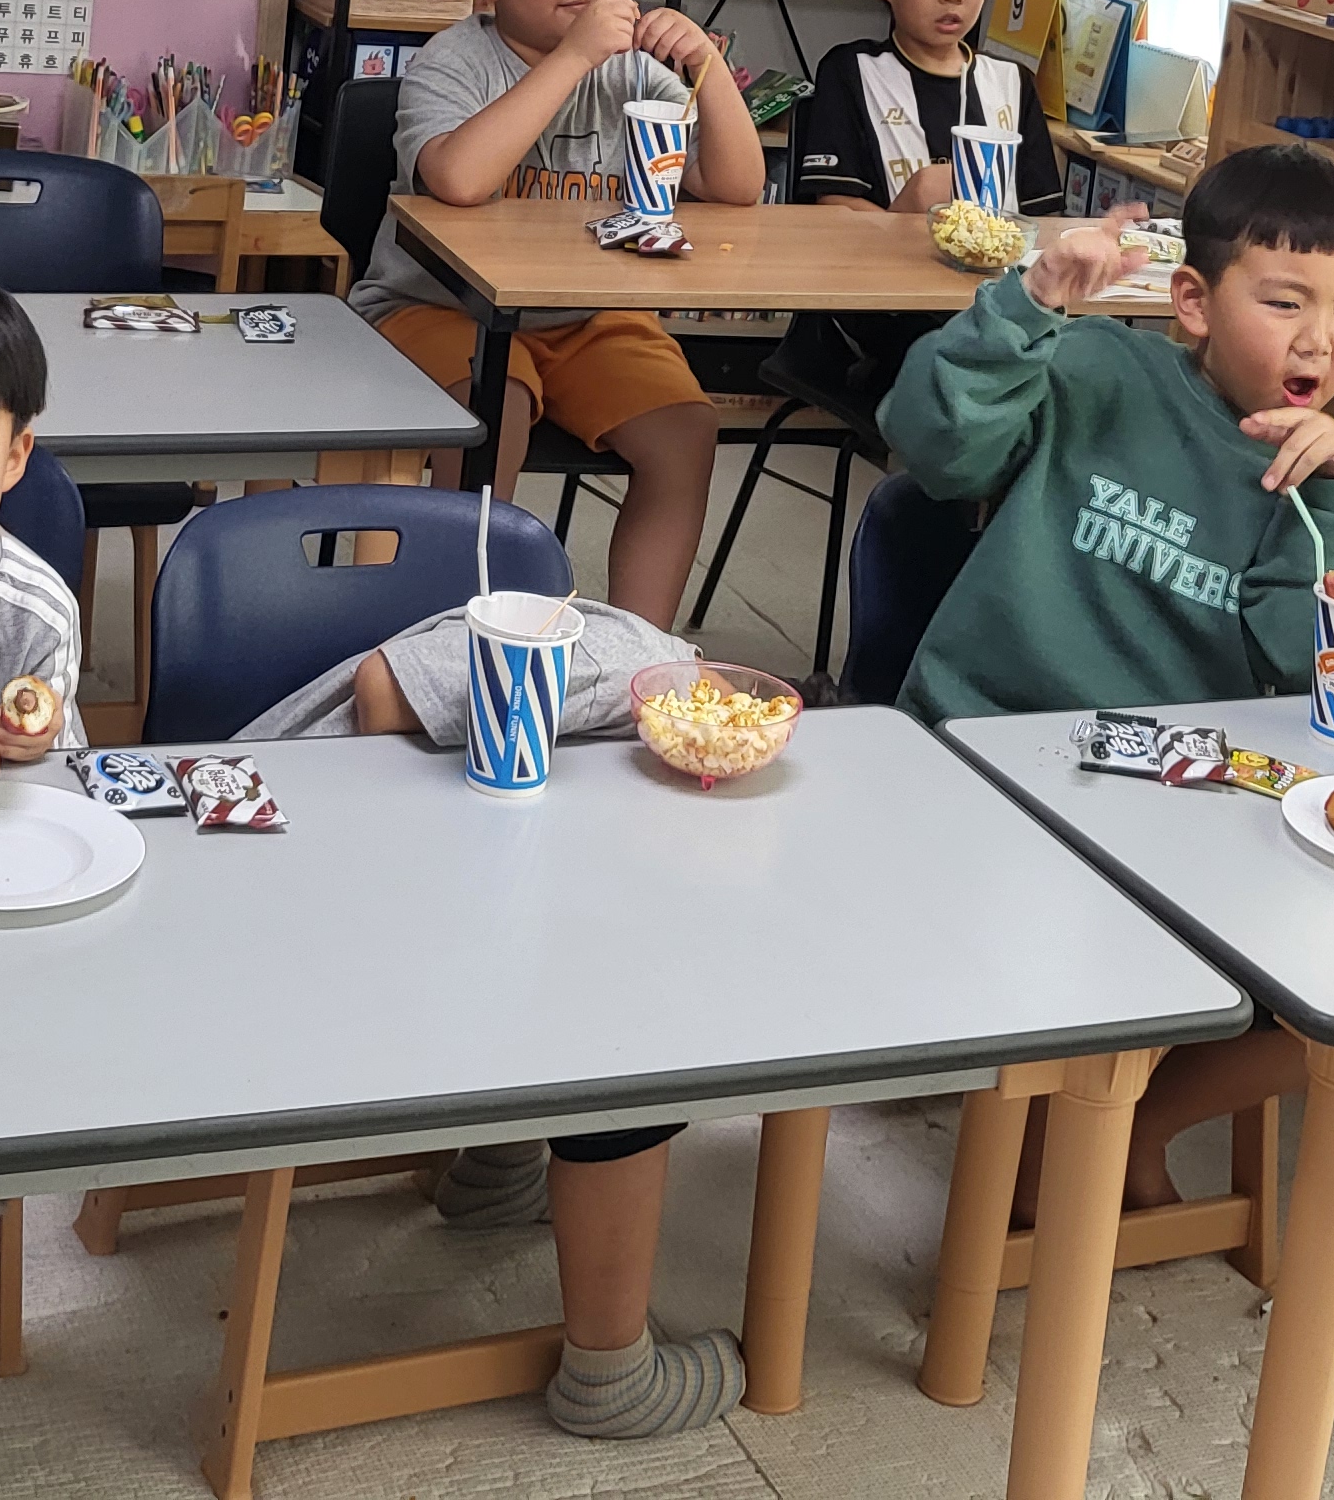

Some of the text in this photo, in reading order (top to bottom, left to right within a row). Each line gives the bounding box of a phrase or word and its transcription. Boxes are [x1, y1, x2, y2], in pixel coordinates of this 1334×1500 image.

[1089, 472, 1198, 549] YALE
[508, 685, 523, 743] DRINK FUNNY
